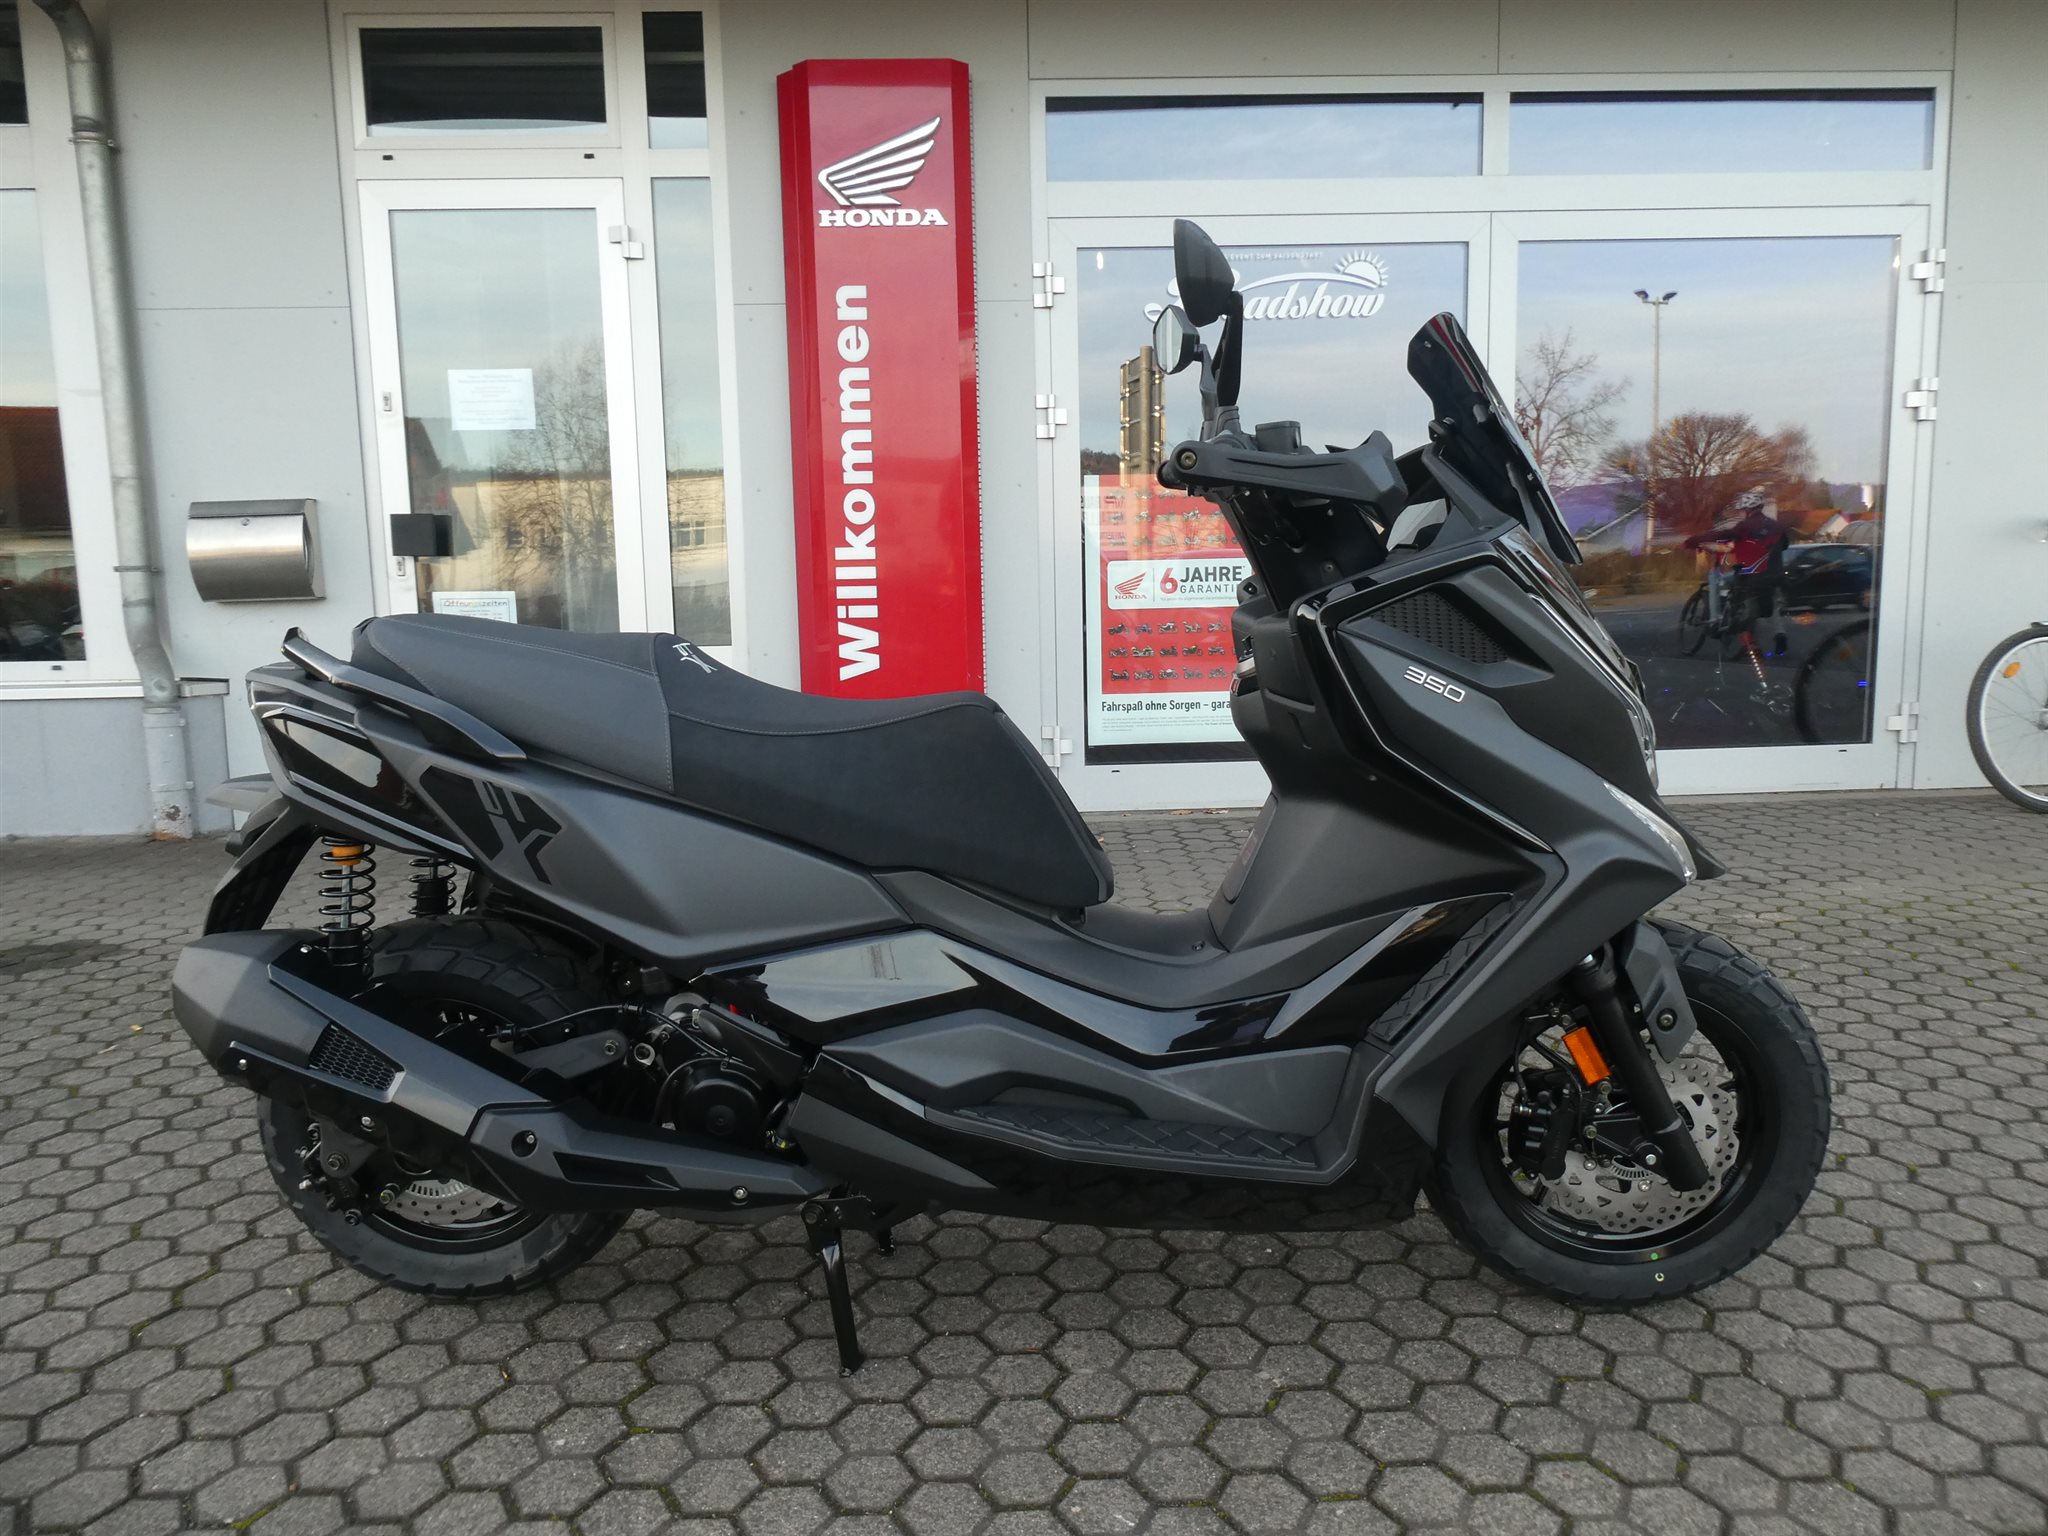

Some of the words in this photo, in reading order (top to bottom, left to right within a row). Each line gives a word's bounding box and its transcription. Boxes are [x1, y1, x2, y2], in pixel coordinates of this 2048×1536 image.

[818, 208, 948, 228] HONDA
[833, 284, 882, 681] Willkommen
[1160, 568, 1178, 594] 6
[1180, 566, 1242, 583] JAHRE
[1180, 584, 1236, 594] GARANTI
[1403, 665, 1466, 703] 350
[1101, 701, 1143, 714] Fahrspaß
[1145, 702, 1167, 711] ohne
[1169, 700, 1201, 712] Sorgen
[1211, 701, 1231, 711] gara
